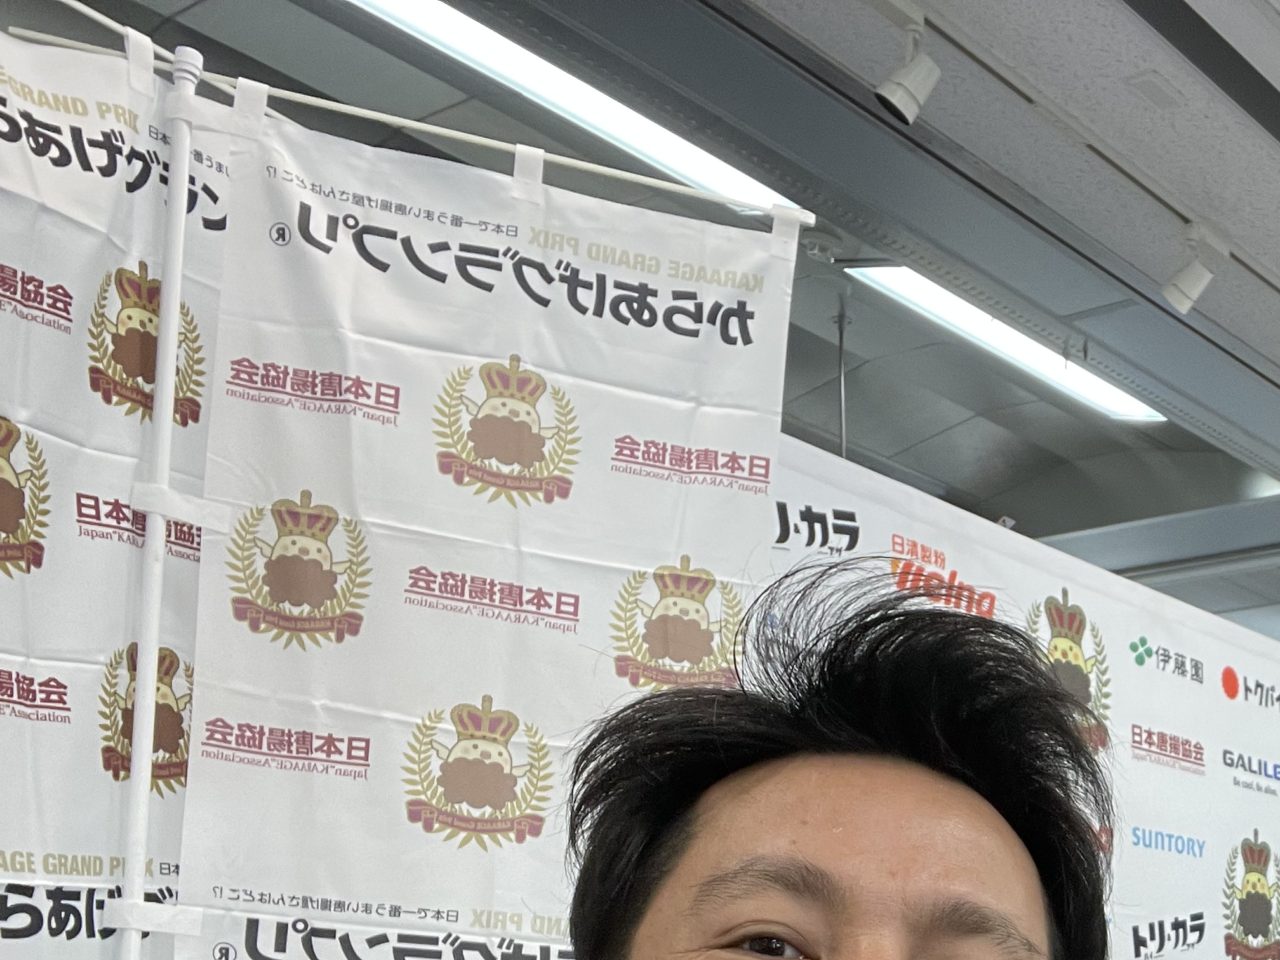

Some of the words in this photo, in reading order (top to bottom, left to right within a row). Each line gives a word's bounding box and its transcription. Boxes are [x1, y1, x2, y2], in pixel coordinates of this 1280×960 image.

[1155, 646, 1204, 685] 伊藤園
[1131, 724, 1205, 763] 日本唐揚協会
[1131, 826, 1206, 859] SUNTORY
[42, 853, 104, 877] GRAND
